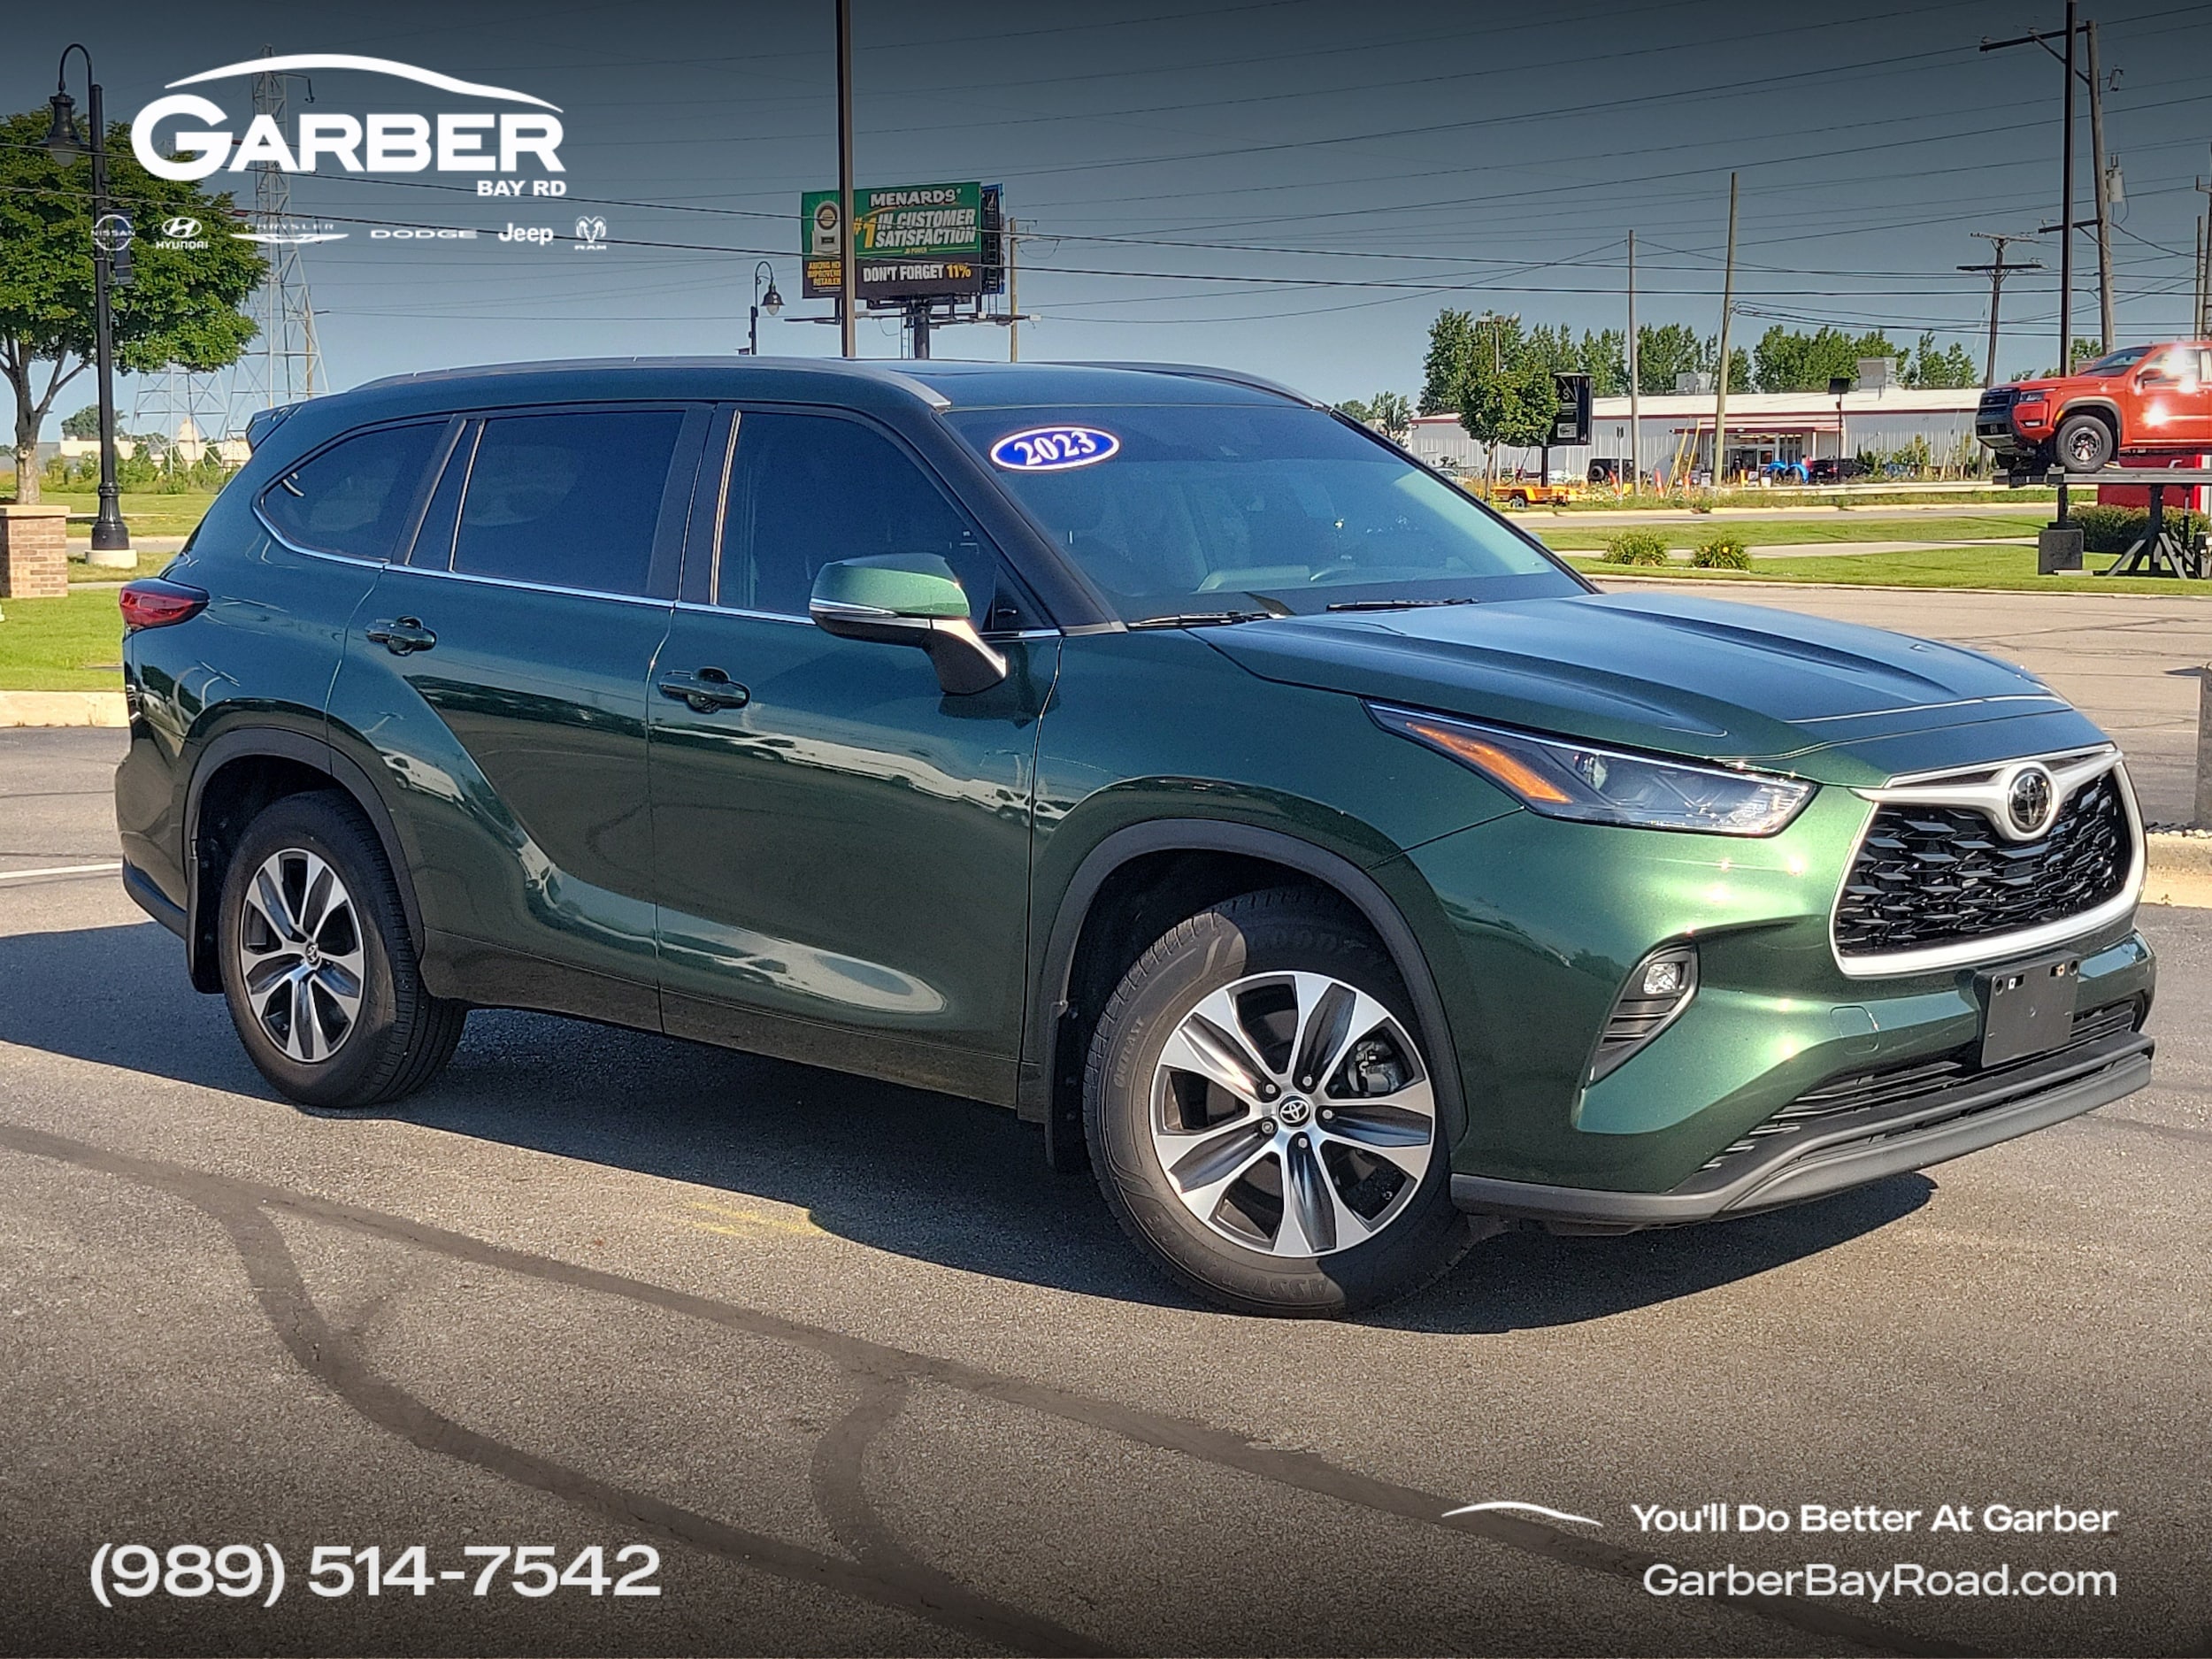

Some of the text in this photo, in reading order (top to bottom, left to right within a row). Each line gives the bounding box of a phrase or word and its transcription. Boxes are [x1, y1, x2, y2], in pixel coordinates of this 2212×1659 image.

[871, 188, 956, 207] MENARDS
[877, 212, 894, 230] IN
[896, 209, 976, 229] CUSTOMER
[875, 227, 977, 248] SATISFACTION
[863, 264, 972, 282] DON'T FORGET 11%
[1014, 431, 1097, 466] 2023
